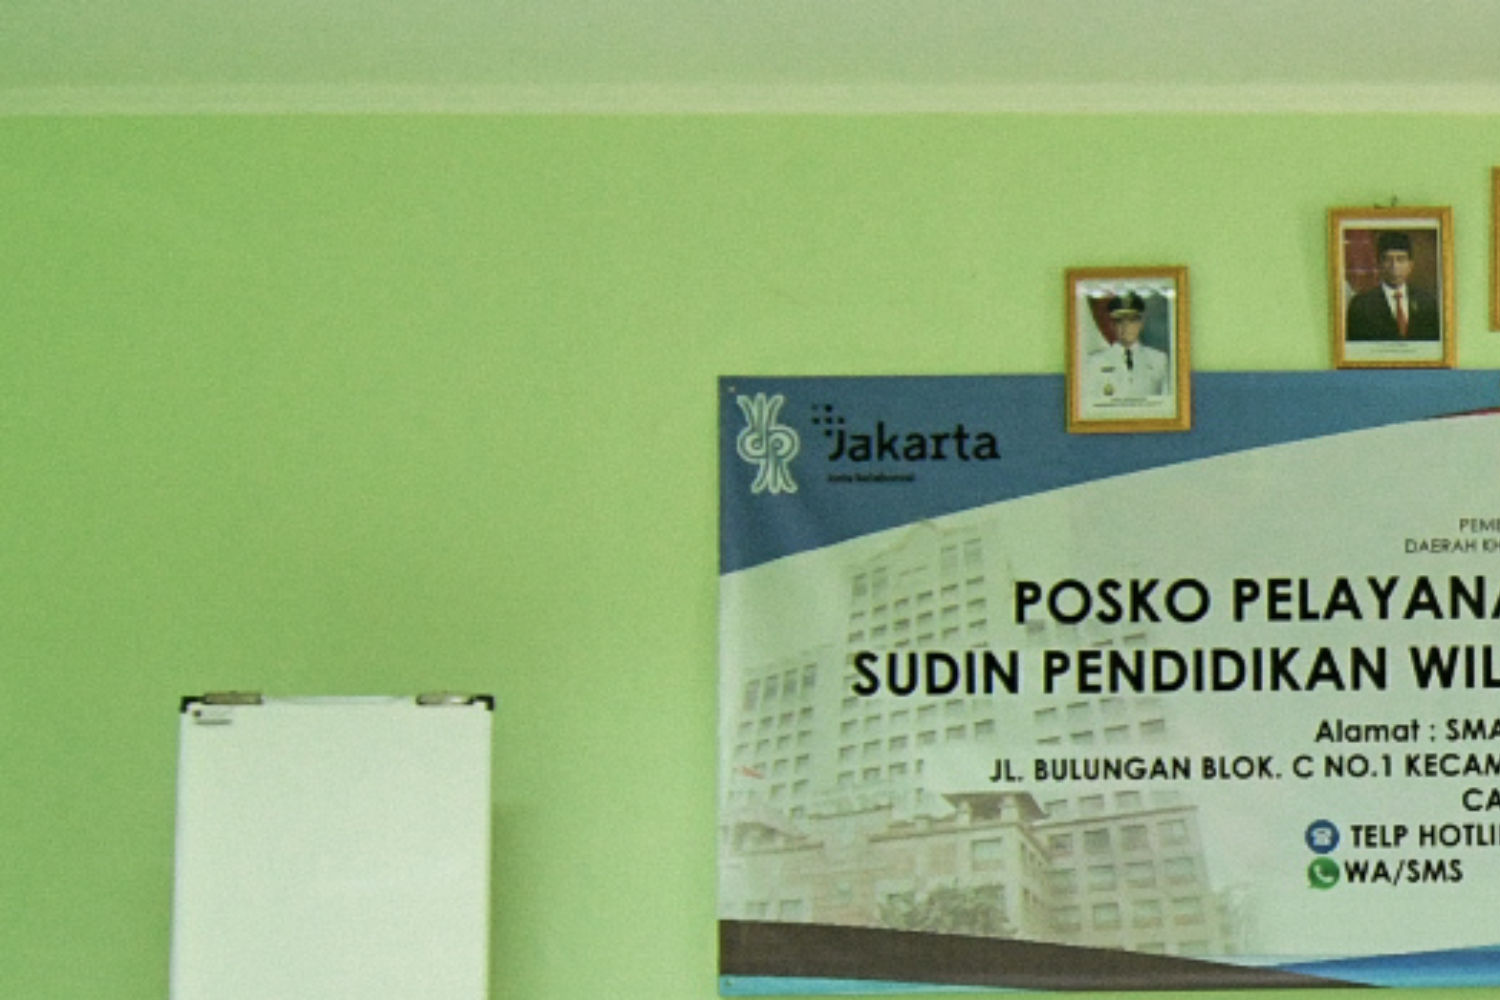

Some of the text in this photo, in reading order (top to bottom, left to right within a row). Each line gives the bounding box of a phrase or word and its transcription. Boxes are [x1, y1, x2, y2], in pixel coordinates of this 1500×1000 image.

[1404, 538, 1477, 554] DAERAH
[1015, 578, 1211, 625] POSKO
[852, 650, 1019, 697] SUDIN
[1044, 646, 1387, 694] PENDIDIKAN
[1315, 718, 1420, 743] Alamat
[989, 759, 1023, 783] JL.
[1034, 756, 1191, 781] BULUNGAN
[1202, 755, 1282, 780] BLOK.
[1292, 754, 1314, 779] C
[1324, 753, 1392, 778] NO.1
[1350, 824, 1409, 848] TELP
[1344, 858, 1463, 886] WA/SMS
